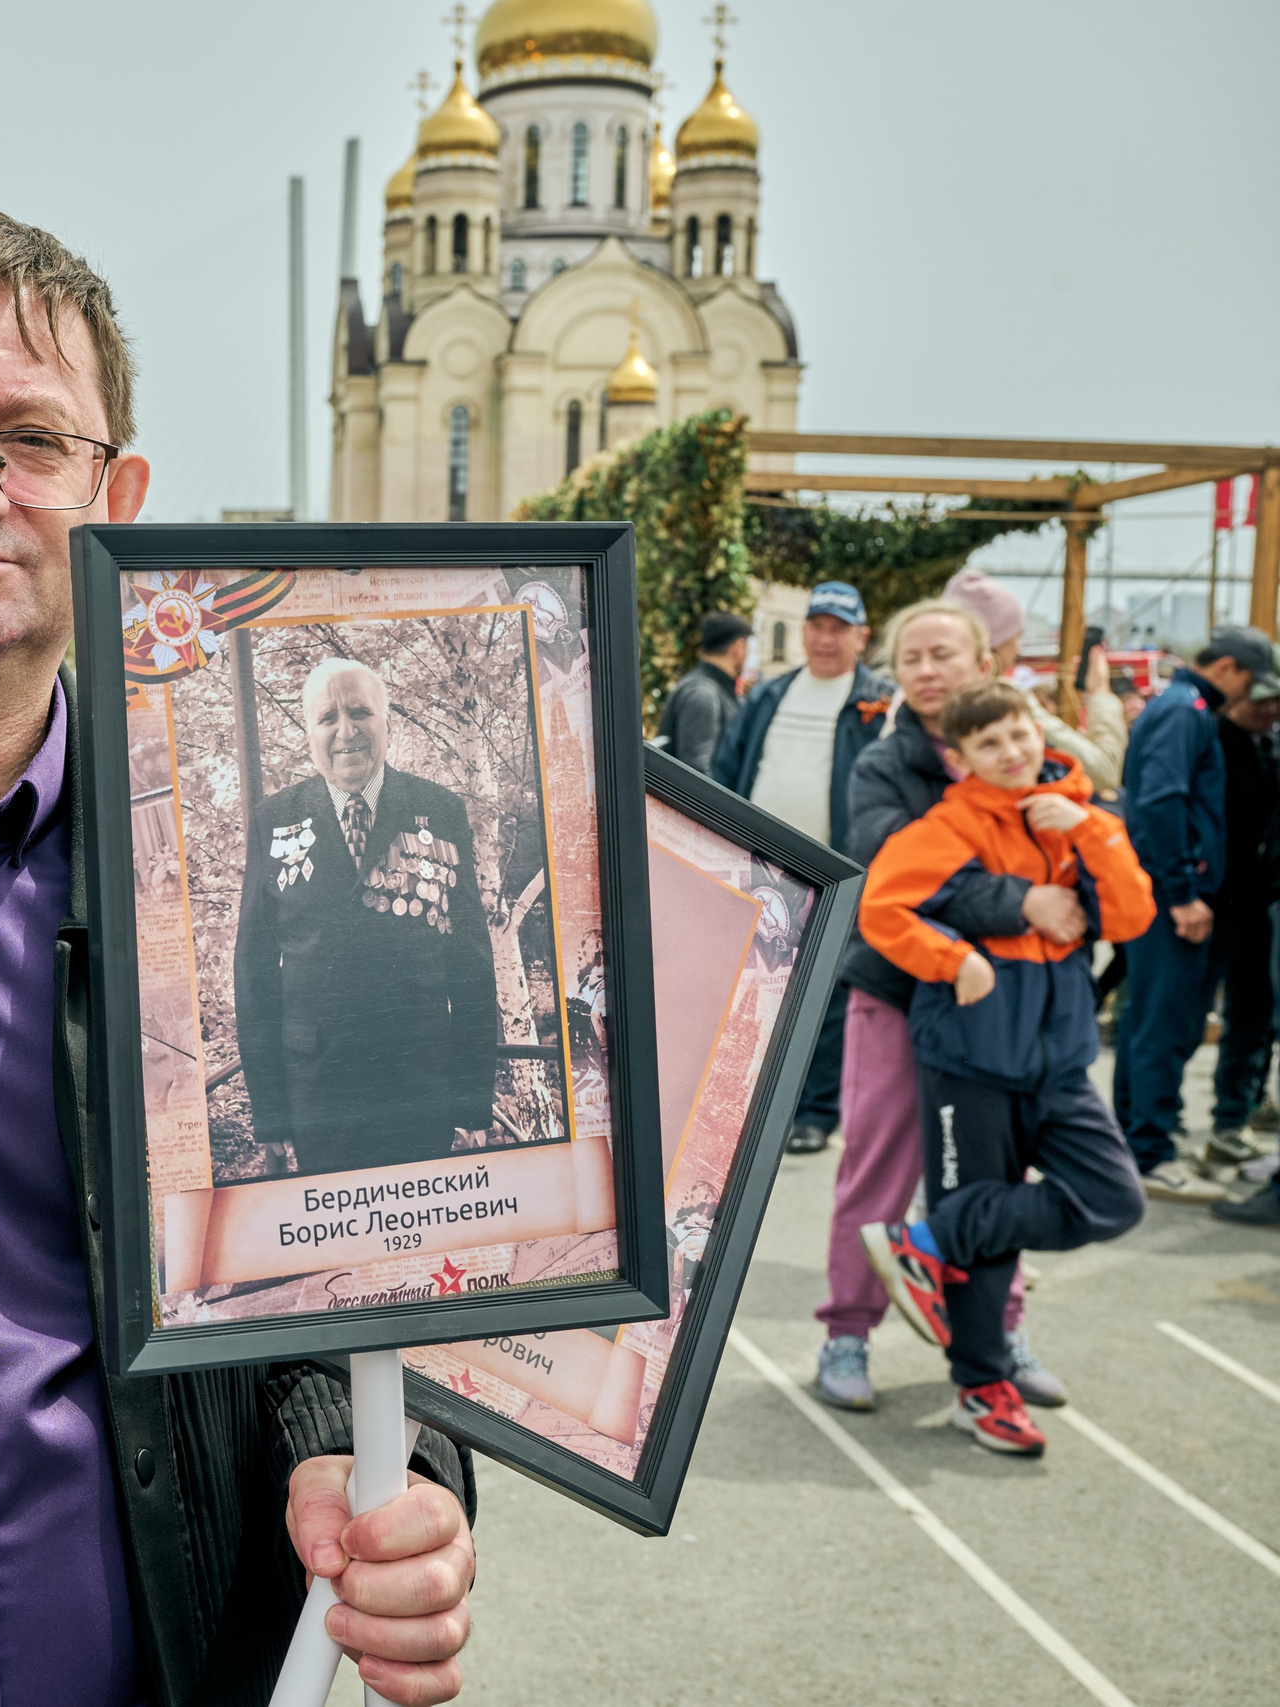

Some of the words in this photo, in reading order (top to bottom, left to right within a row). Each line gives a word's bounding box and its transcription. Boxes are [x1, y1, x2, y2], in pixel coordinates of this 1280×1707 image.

[304, 1165, 490, 1213] Бердичевский
[279, 1218, 359, 1247] Борис
[365, 1197, 519, 1235] Леонтьевич
[383, 1233, 423, 1252] 1929
